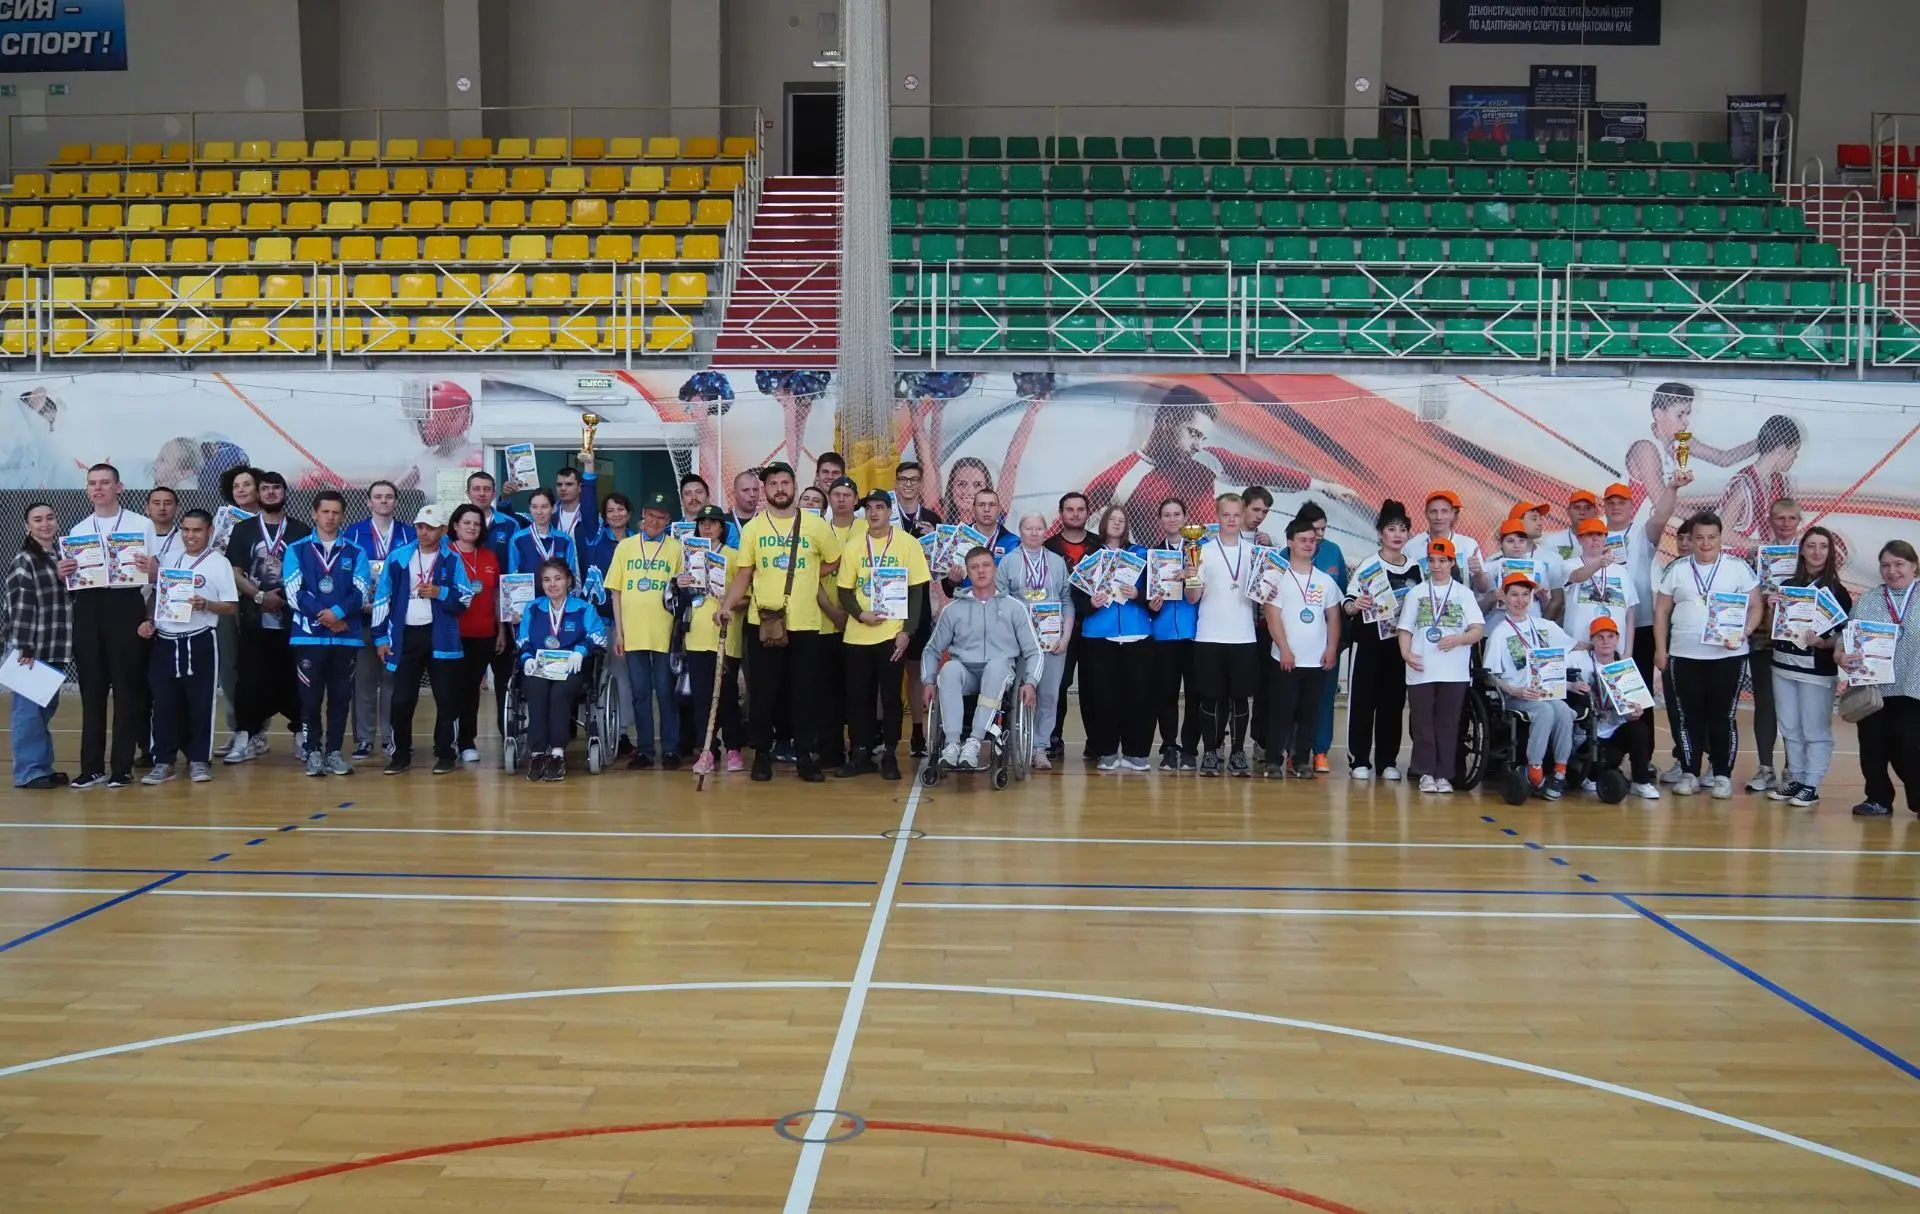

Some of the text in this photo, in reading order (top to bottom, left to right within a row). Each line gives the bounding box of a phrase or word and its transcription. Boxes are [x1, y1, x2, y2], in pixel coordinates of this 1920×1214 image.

[1611, 6, 1634, 17] ЦЕНТР
[1469, 19, 1633, 32] ПО АДАПТИВНОМУ СПОРТУ В КАМЧАТСКОМ КРАЕ
[1, 31, 111, 55] СПОРТ!
[581, 379, 609, 387] ВЫХОД
[759, 535, 809, 548] ПОВЕЬ
[763, 557, 769, 568] В
[626, 579, 634, 591] В
